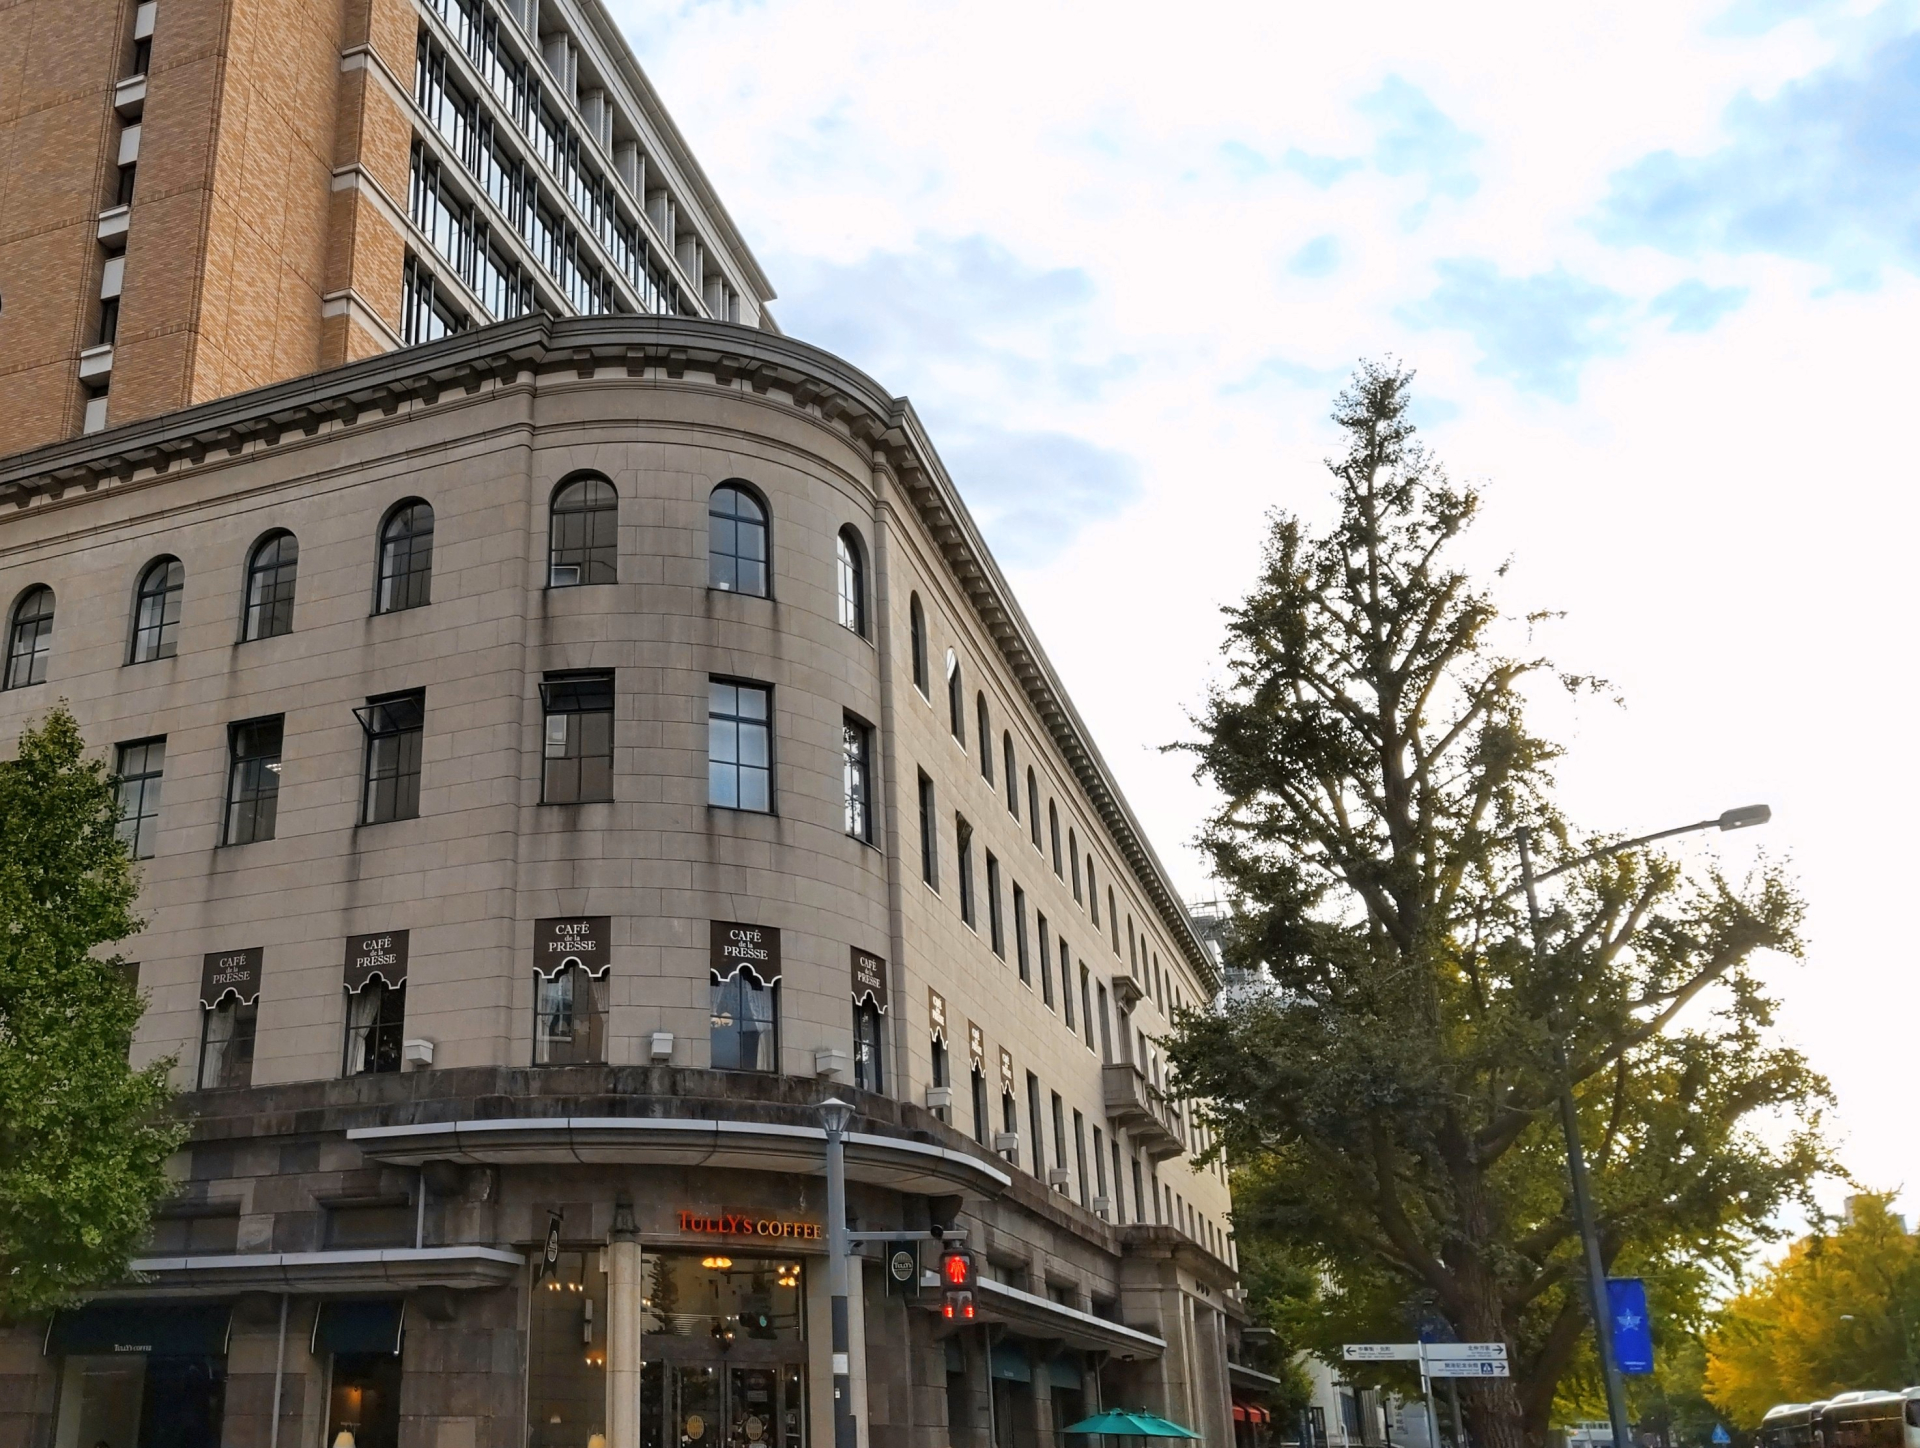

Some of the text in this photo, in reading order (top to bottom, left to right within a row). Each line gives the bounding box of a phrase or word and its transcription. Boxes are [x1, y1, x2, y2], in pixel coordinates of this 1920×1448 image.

[555, 921, 590, 935] CAFÉ
[363, 935, 392, 951] CAFÉ
[730, 929, 762, 943] CAFÉ
[549, 941, 596, 952] PRESSE
[723, 945, 768, 960] PRESSE
[219, 953, 247, 968] CAFÉ
[356, 953, 397, 968] PRESSE
[860, 956, 877, 971] CAFÉ
[213, 970, 250, 985] PRESSE
[857, 971, 881, 989] PRESSE
[756, 1219, 823, 1240] COFFEE
